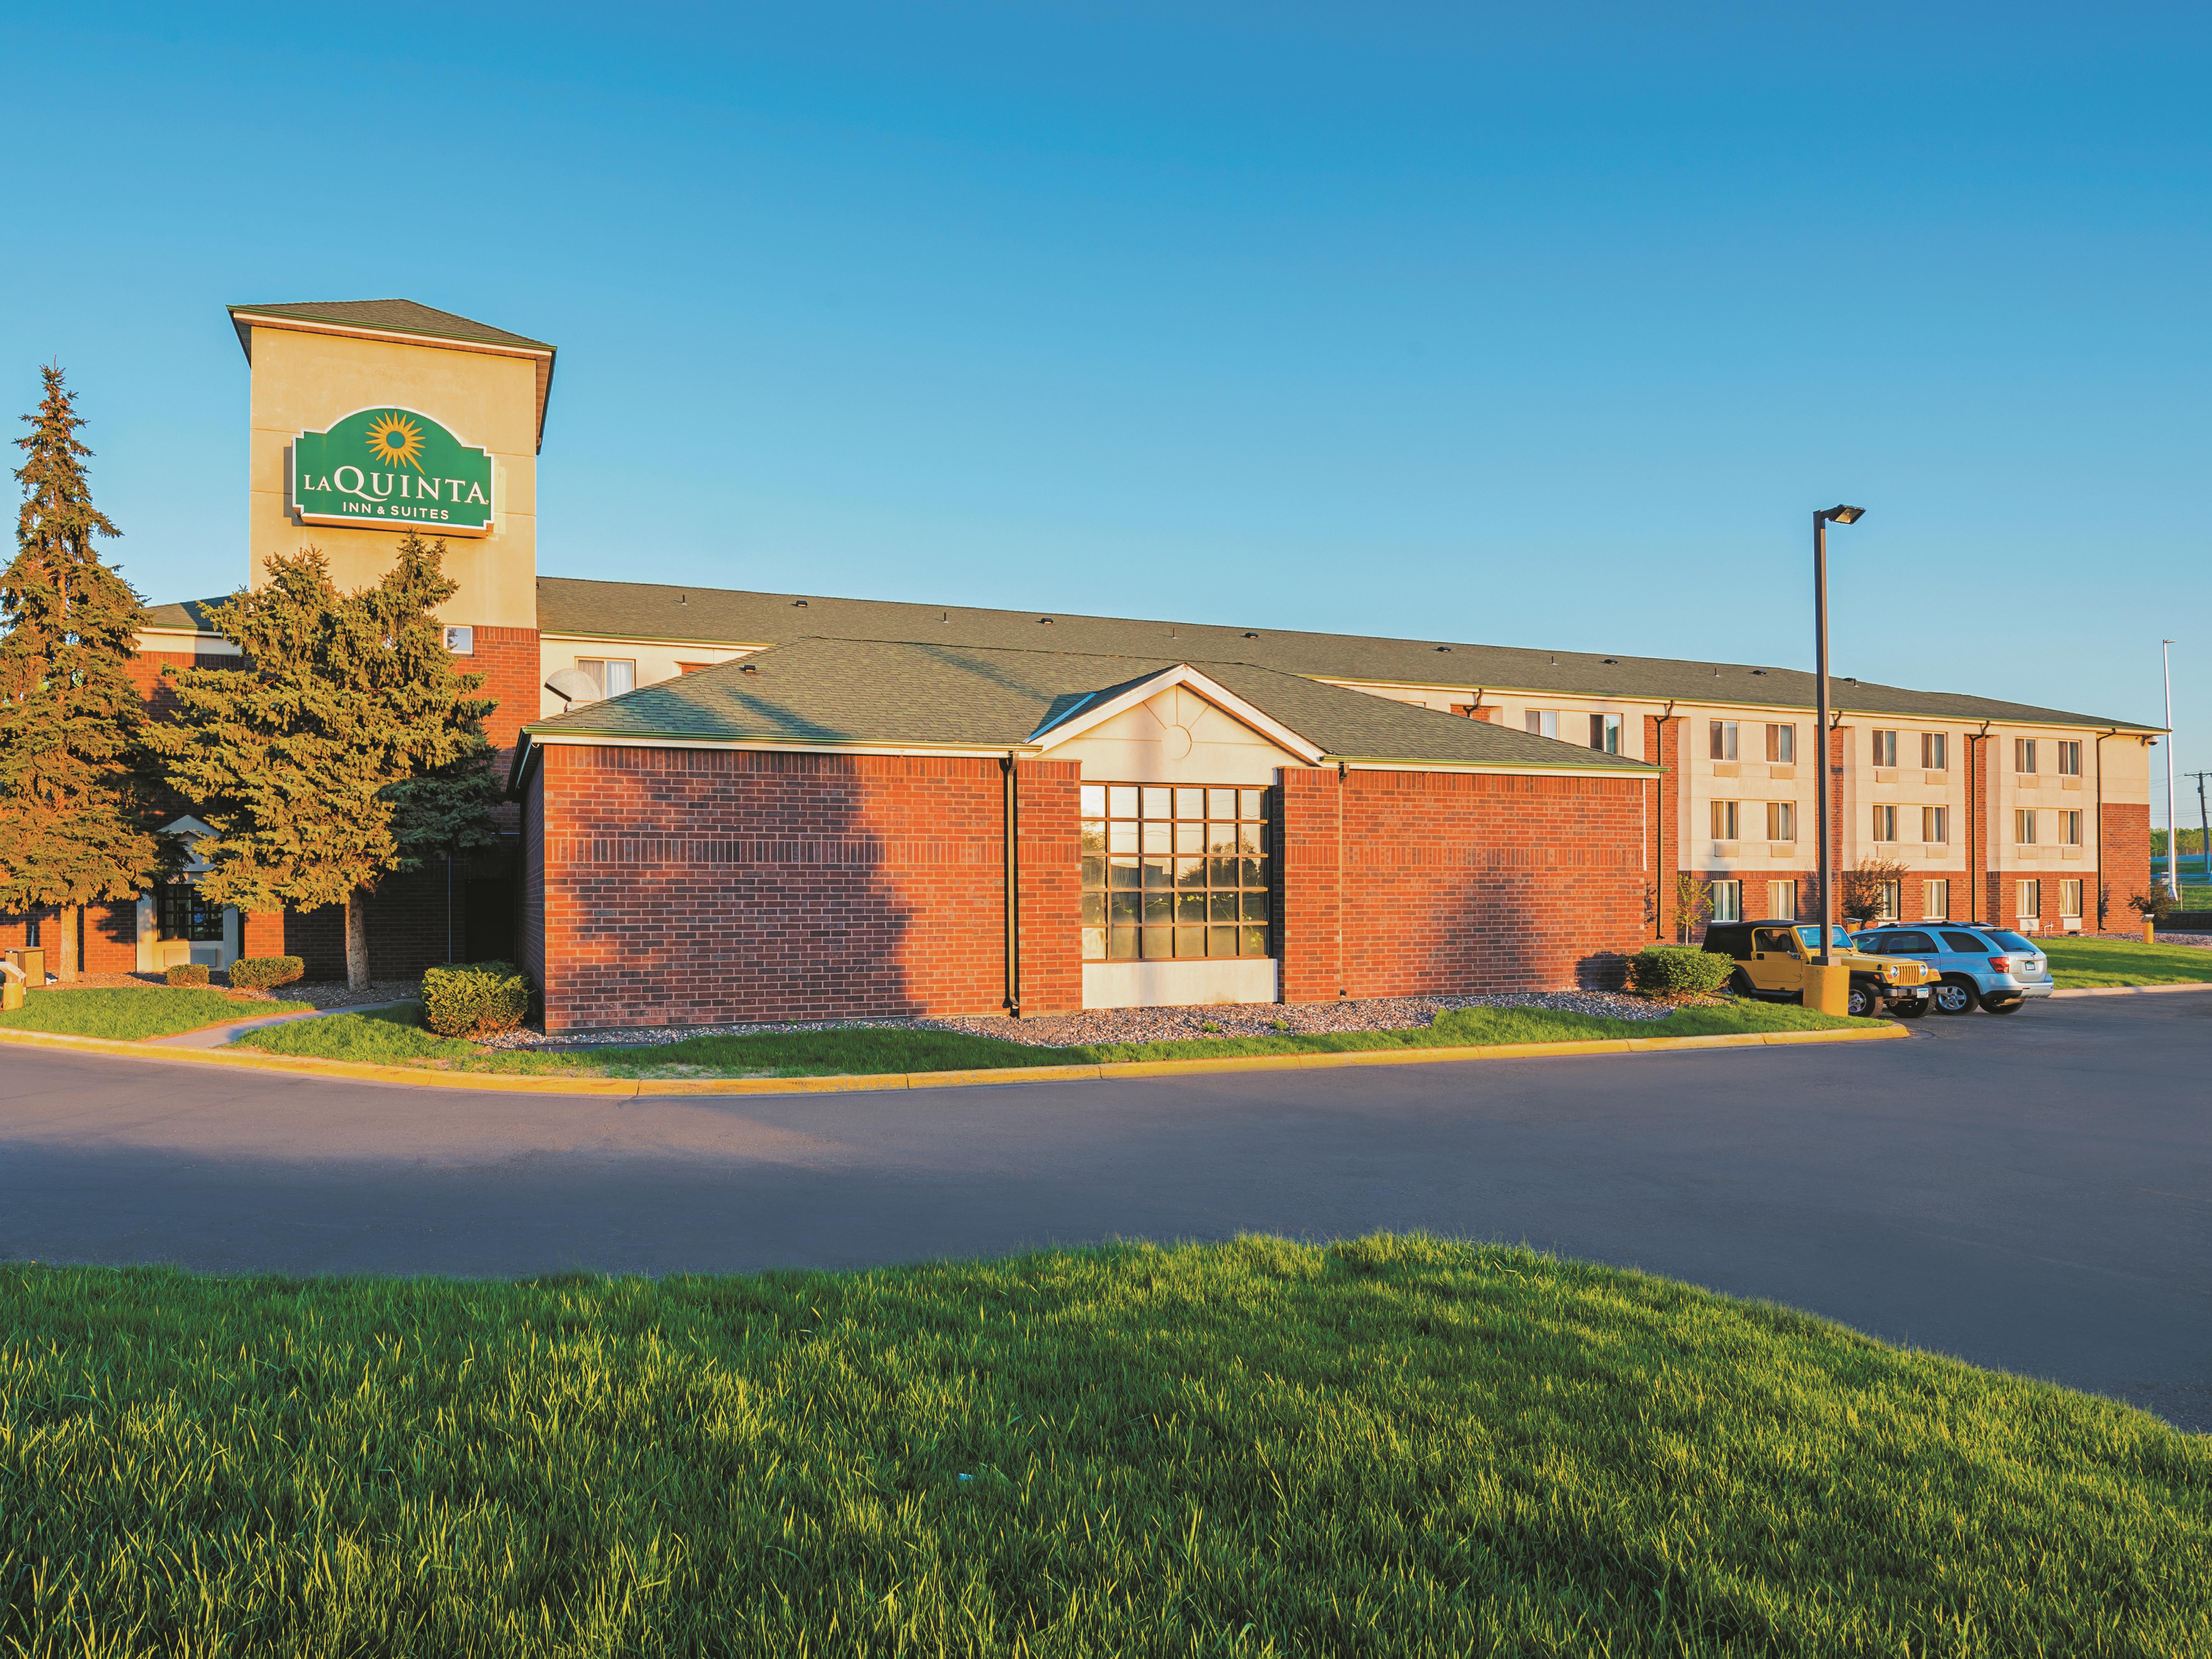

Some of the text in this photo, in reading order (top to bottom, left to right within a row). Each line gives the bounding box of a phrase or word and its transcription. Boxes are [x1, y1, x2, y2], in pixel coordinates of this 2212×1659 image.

[304, 466, 489, 505] LA QUINTA
[343, 502, 449, 520] INN & SUITES
